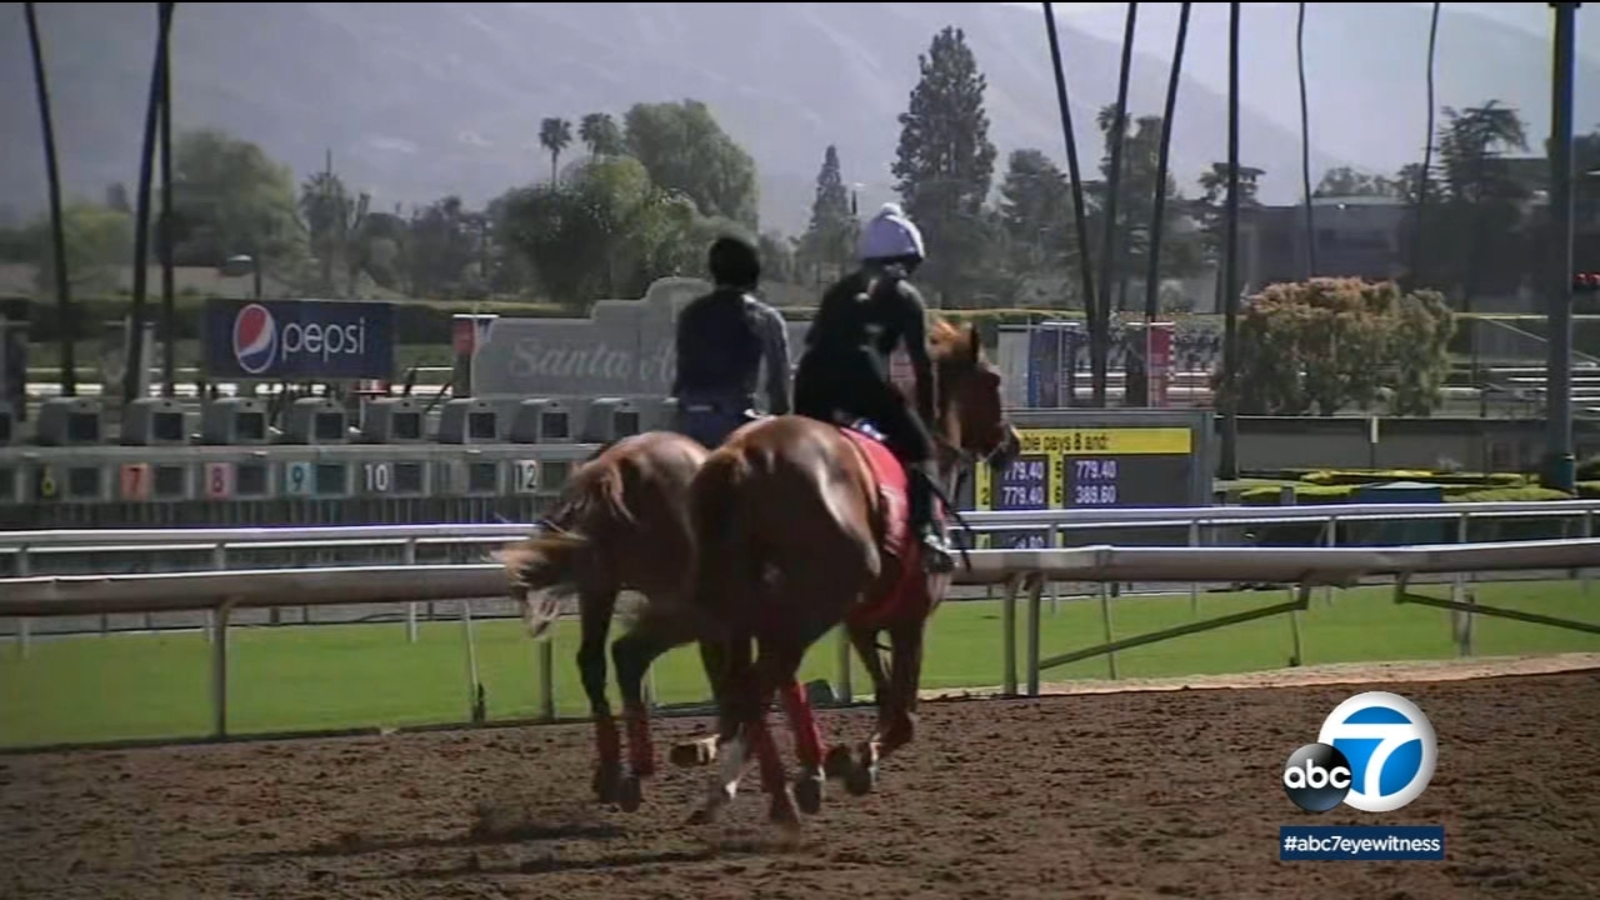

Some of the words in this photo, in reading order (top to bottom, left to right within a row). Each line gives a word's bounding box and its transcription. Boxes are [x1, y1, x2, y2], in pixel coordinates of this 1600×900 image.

[281, 316, 366, 363] pepsi
[508, 337, 634, 380] Santa
[1044, 435, 1072, 455] pays
[1074, 431, 1082, 451] 8
[128, 465, 141, 494] 7
[212, 465, 224, 494] 8
[291, 464, 305, 492] 9
[364, 463, 388, 491] 10
[514, 462, 537, 490] 12
[1075, 459, 1117, 479] 779.40
[1002, 485, 1045, 506] 779.40
[1075, 484, 1117, 504] 389.60
